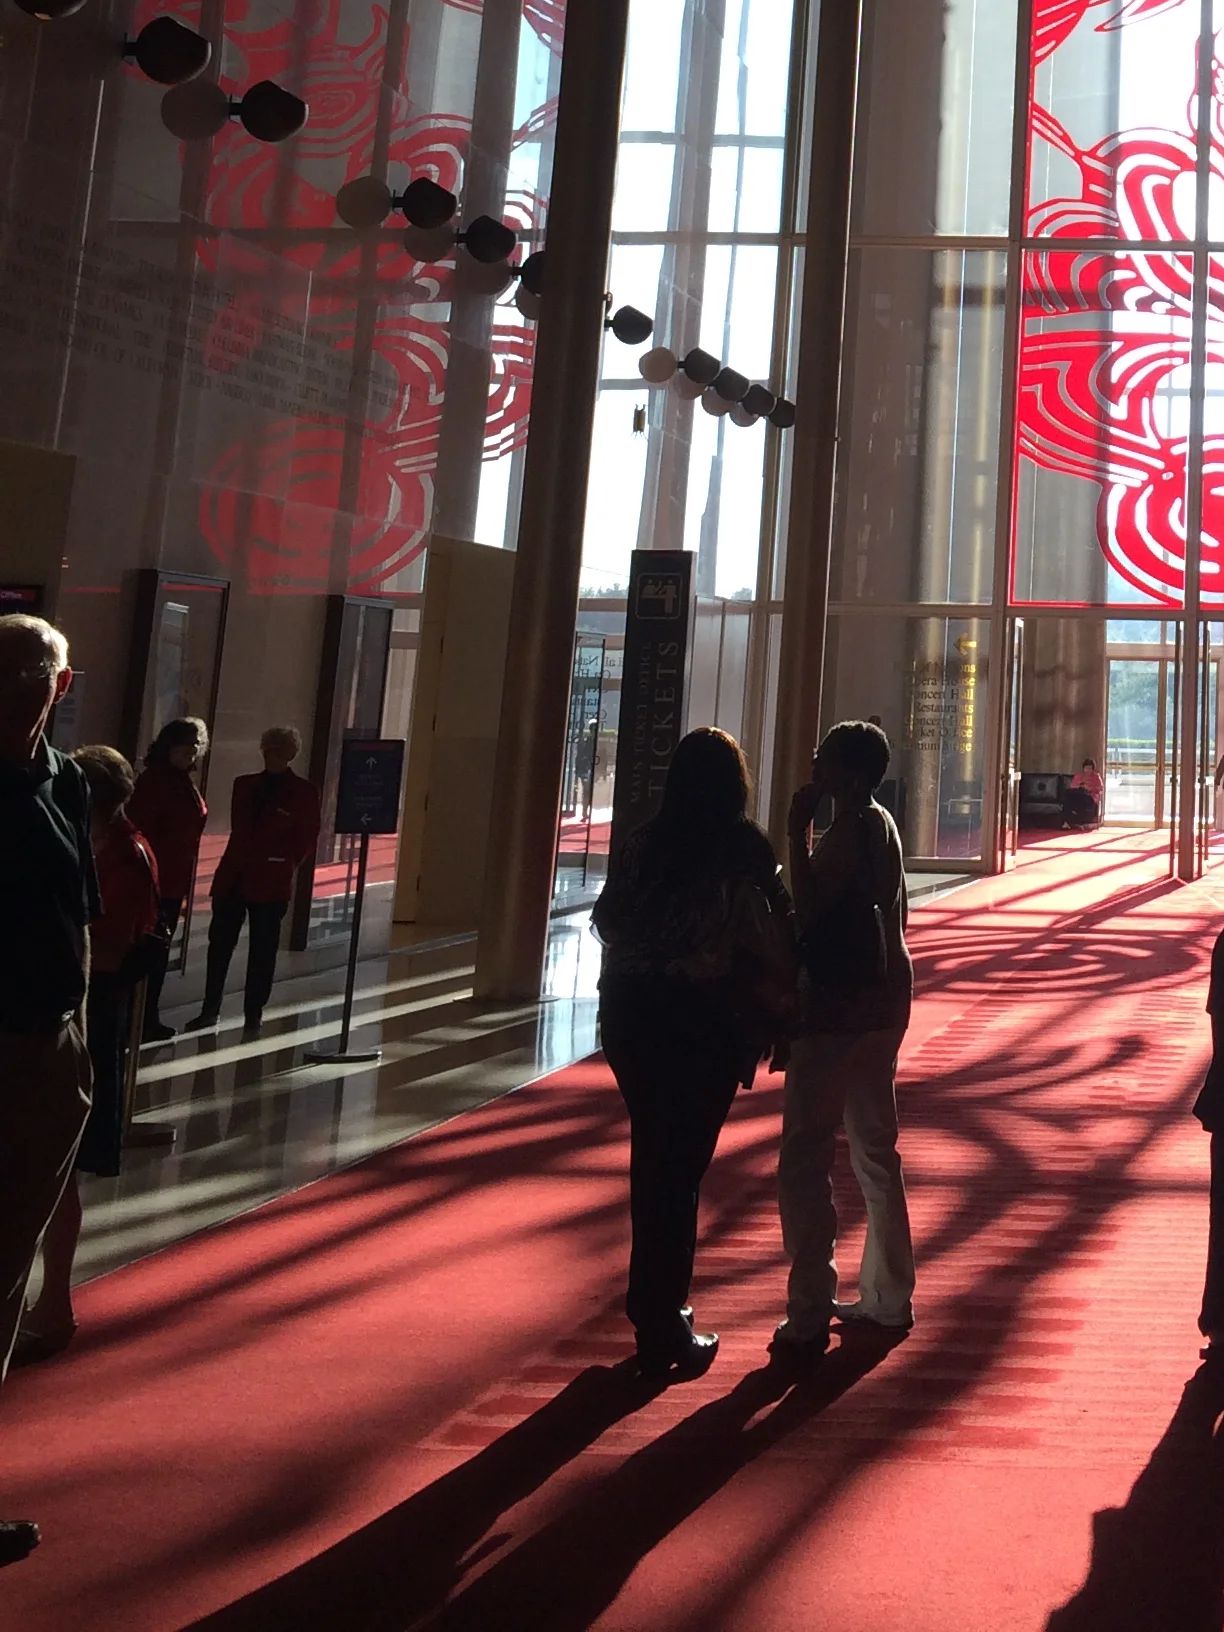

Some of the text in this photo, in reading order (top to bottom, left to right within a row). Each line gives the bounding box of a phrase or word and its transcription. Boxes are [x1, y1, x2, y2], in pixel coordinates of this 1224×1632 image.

[633, 703, 648, 755] TICKET
[647, 640, 681, 799] TICKETS
[630, 761, 645, 804] MAIN
